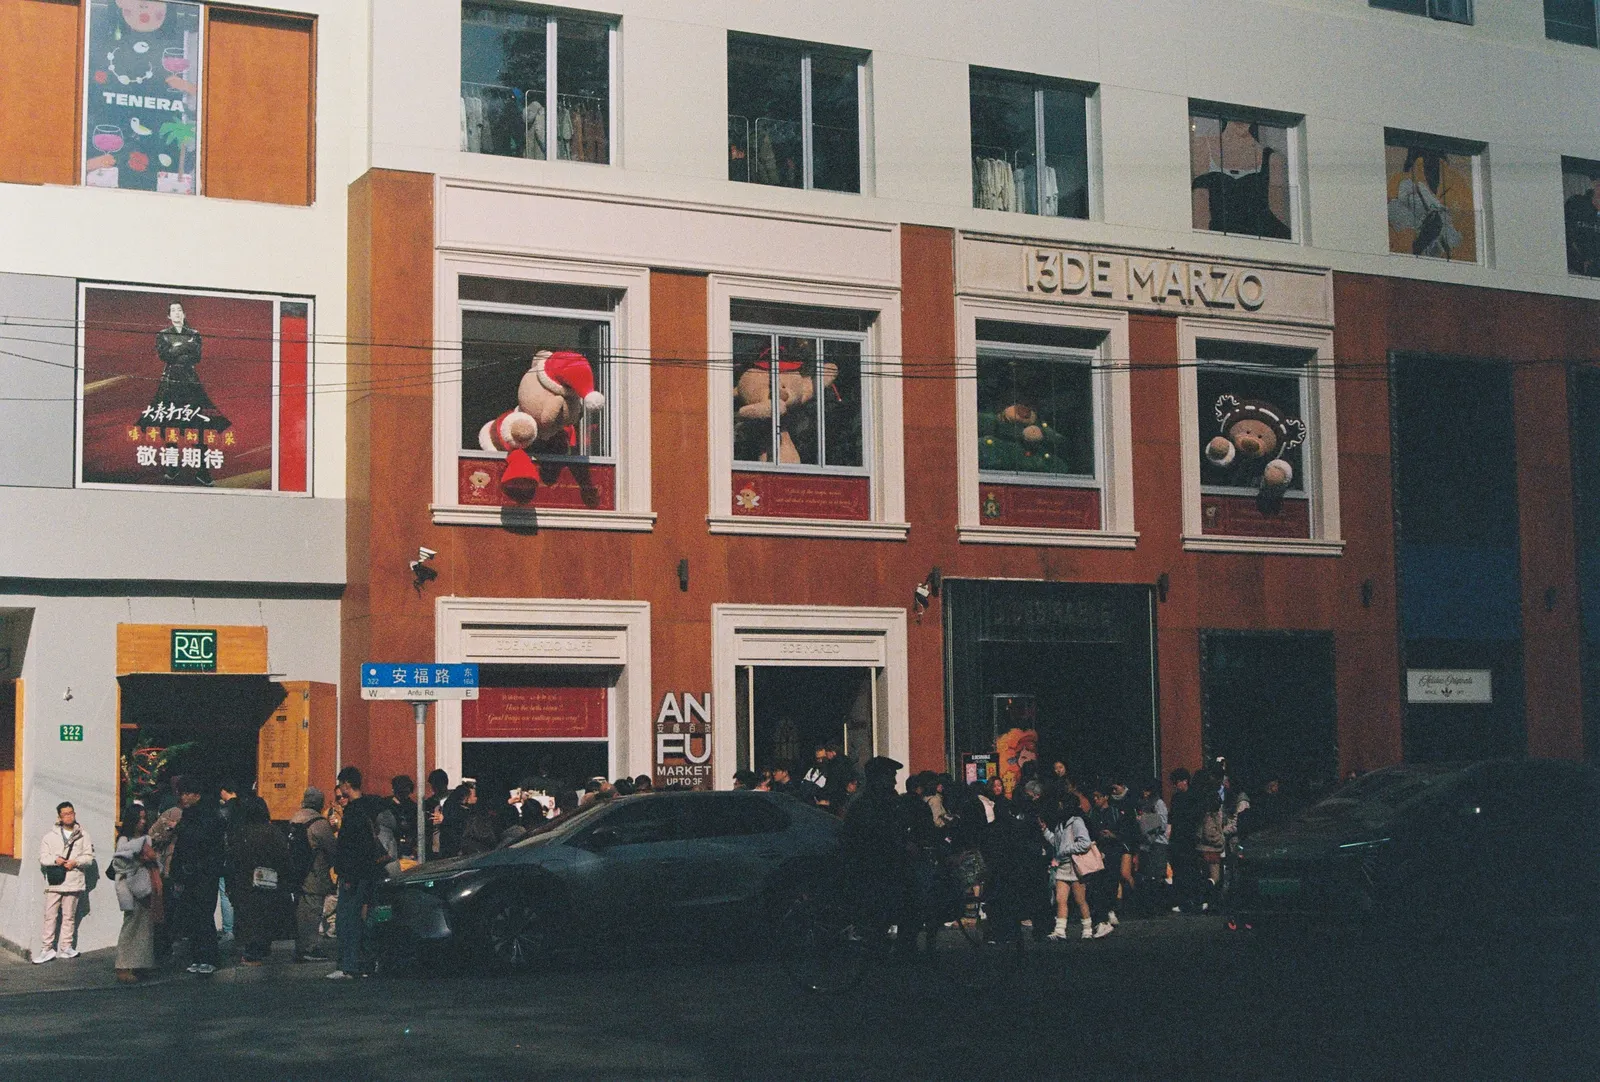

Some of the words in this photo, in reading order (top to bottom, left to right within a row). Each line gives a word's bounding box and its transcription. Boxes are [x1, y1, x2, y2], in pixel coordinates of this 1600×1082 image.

[102, 92, 185, 112] TENERA
[1125, 257, 1266, 312] MARZO
[136, 445, 224, 469] 敬请期待
[175, 636, 213, 659] RAC
[392, 667, 450, 684] 安福路
[464, 668, 473, 677] 东
[407, 689, 422, 697] Anfu
[657, 692, 711, 723] AN
[63, 726, 80, 736] 322
[657, 733, 711, 764] FU
[657, 766, 711, 776] MARKET
